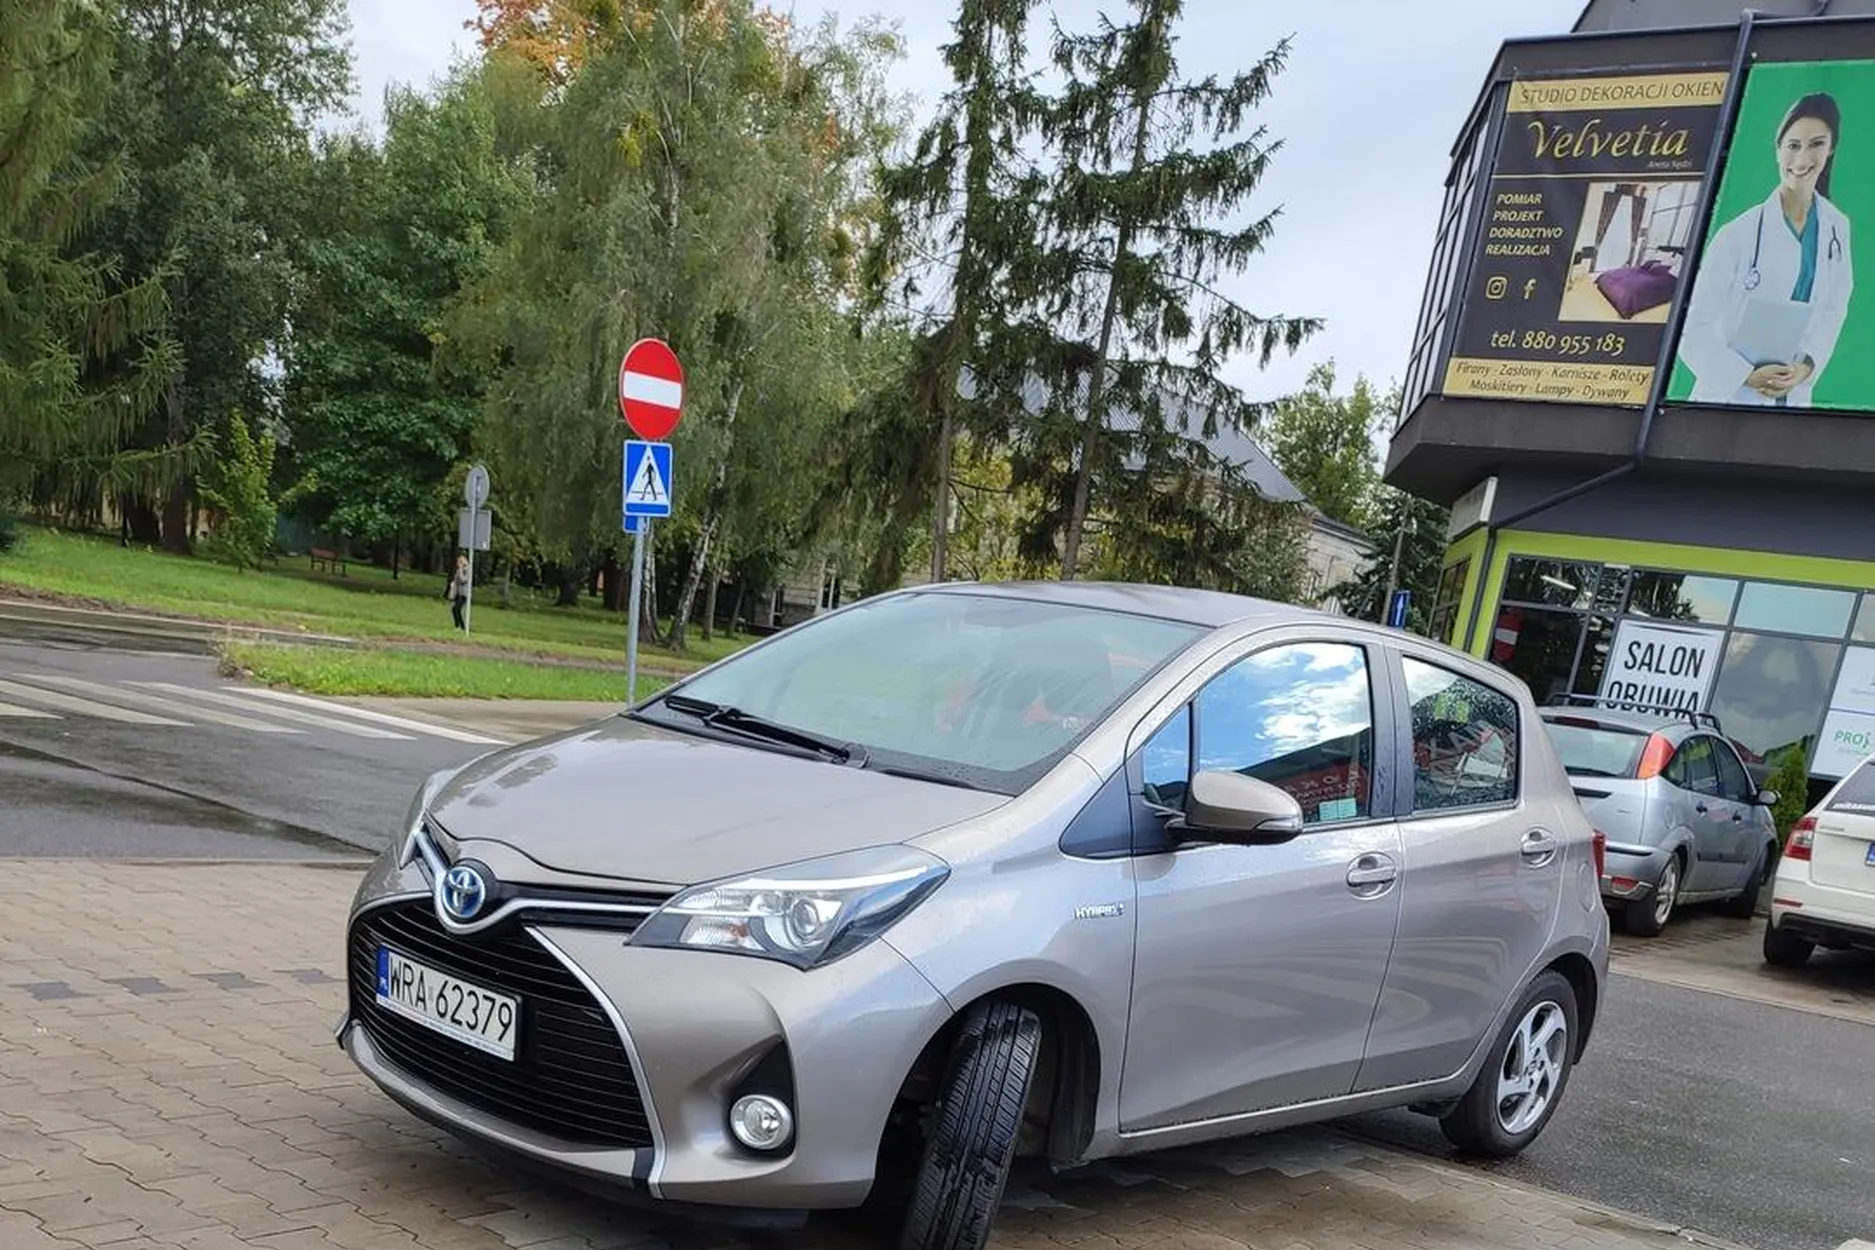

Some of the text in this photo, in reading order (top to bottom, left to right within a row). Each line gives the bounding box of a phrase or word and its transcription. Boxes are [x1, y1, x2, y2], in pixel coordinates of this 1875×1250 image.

[1520, 79, 1724, 104] STUDIO DEKORACJI OKIEN
[1527, 119, 1689, 159] Velvetia
[1497, 193, 1543, 205] POMIAR
[1493, 210, 1544, 222] PROJEKT
[1489, 227, 1563, 239] DORADZTWO
[1485, 244, 1550, 256] REALIZACJA
[1490, 330, 1626, 357] tel. 880 955 183
[1456, 362, 1490, 377] Firany
[1551, 367, 1601, 381] Karnisze
[1609, 368, 1649, 386] Rolety
[1469, 379, 1630, 399] Moskitiery Lampy Dywany
[1624, 640, 1706, 679] SALON
[1606, 680, 1699, 720] OBUWIA
[390, 956, 513, 1042] WRA 62379
